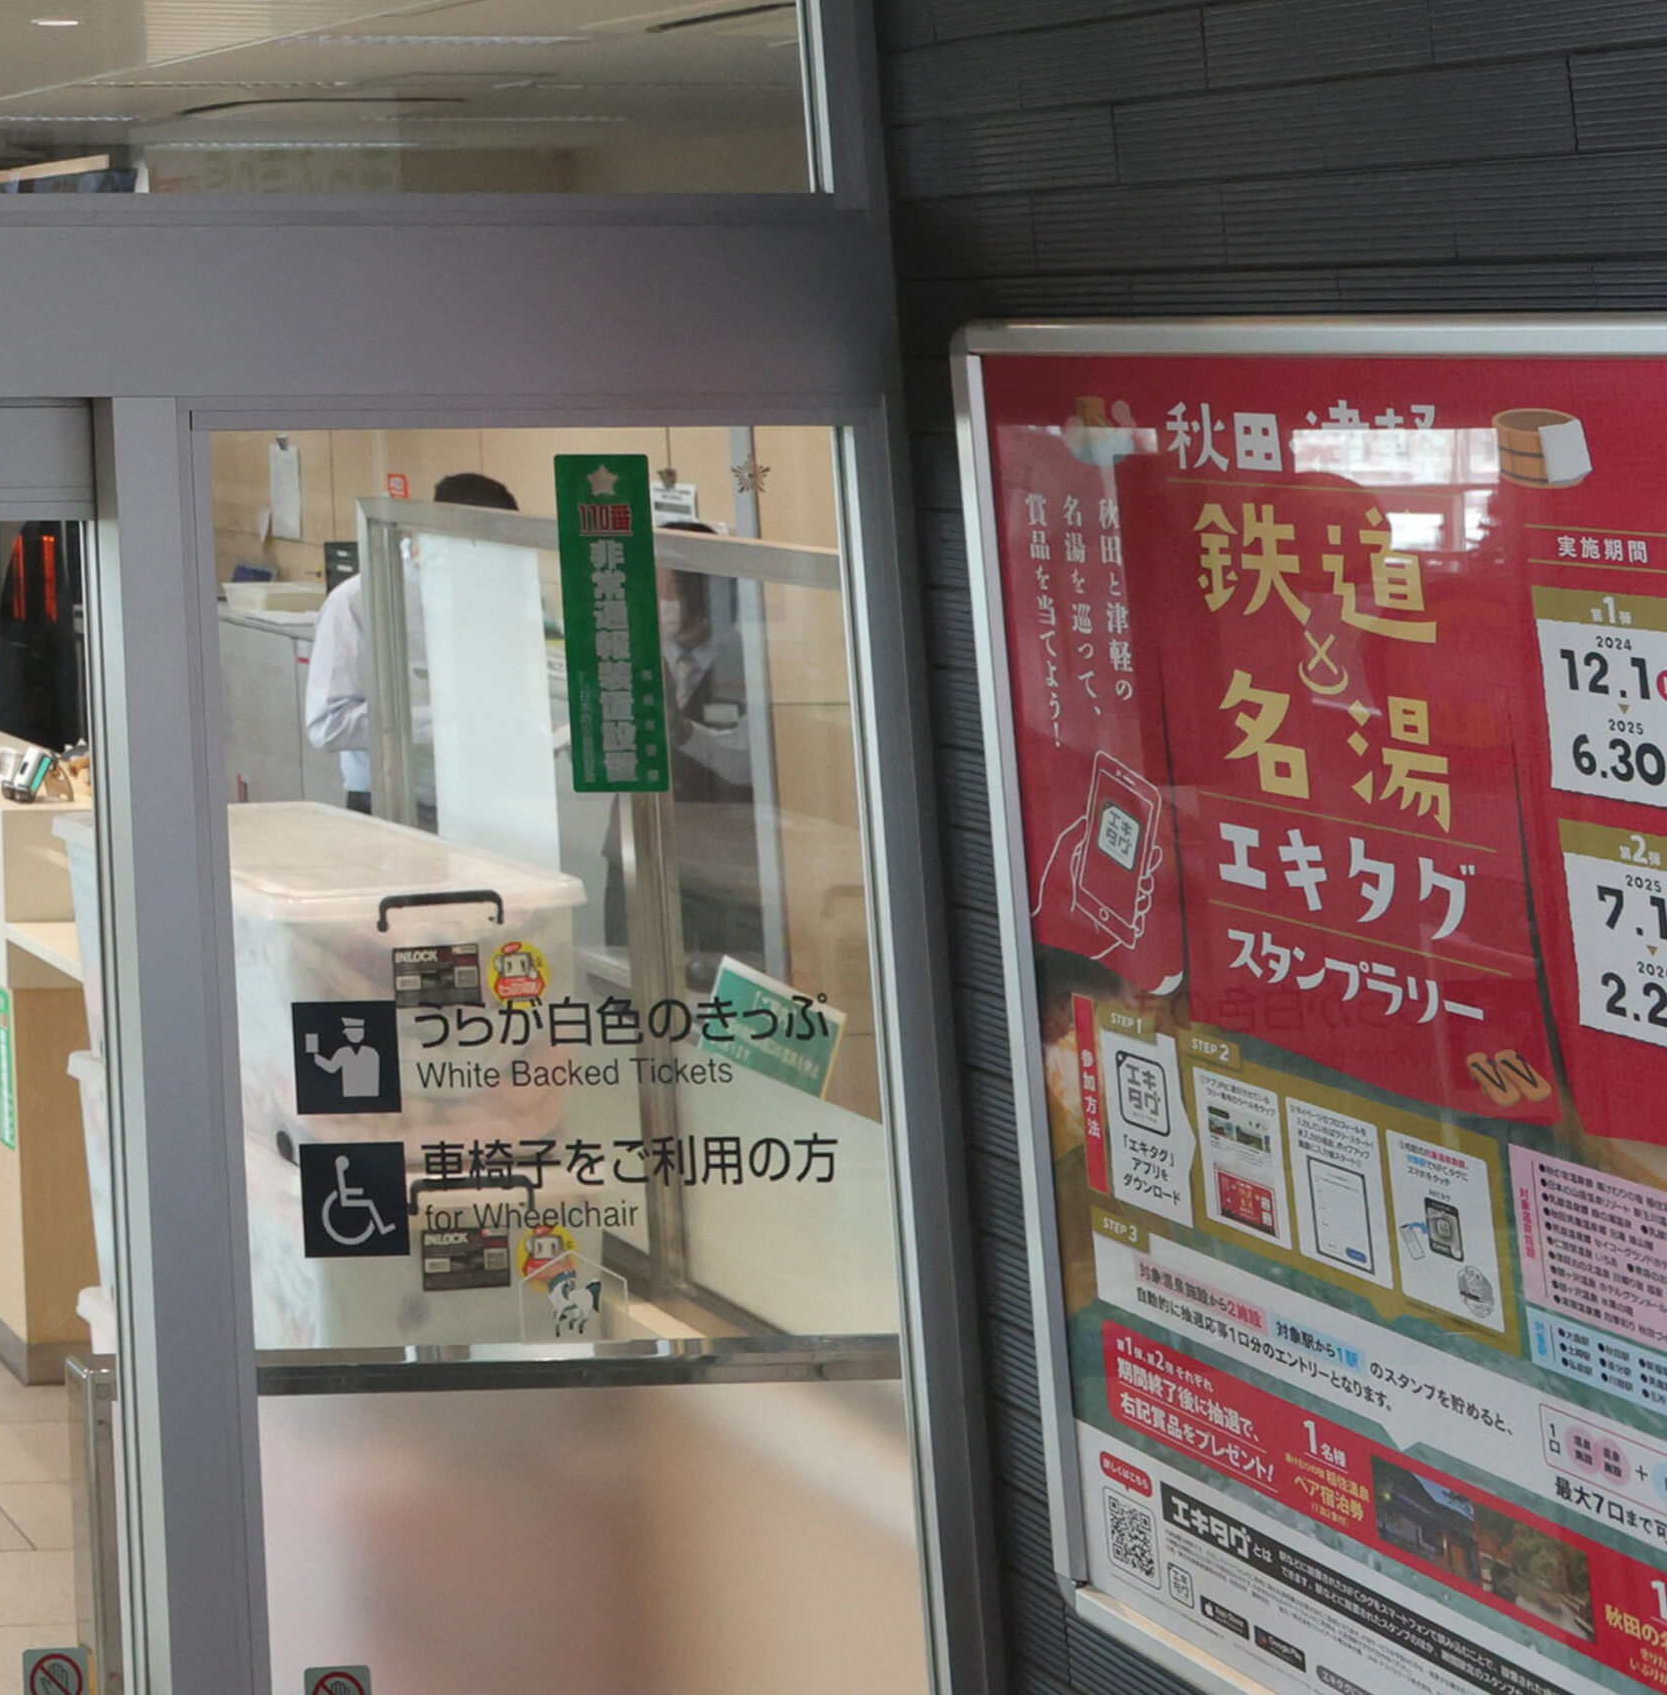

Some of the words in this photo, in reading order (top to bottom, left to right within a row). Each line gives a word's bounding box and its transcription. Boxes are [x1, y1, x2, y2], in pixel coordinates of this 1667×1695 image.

[579, 504, 632, 535] 110番
[1556, 535, 1649, 564] 実施期間
[1062, 494, 1102, 716] 名湯を巡って、
[1097, 497, 1134, 702] 秋田と津軽の
[1595, 636, 1633, 652] 2024
[1559, 648, 1651, 701] 12.1
[1607, 718, 1645, 736] 2025
[1218, 669, 1454, 834] 名湯
[1572, 734, 1667, 786] 6.30
[1218, 822, 1477, 941] エキタグ
[1624, 874, 1662, 893] 2025
[1228, 927, 1486, 1024] スタンプラリー
[1110, 1012, 1135, 1028] STEP
[1191, 1037, 1218, 1055] STEP
[1219, 1044, 1230, 1061] 2
[417, 1060, 501, 1089] White
[512, 1058, 620, 1088] Backed
[629, 1056, 734, 1086] Tickets
[1080, 1048, 1101, 1140] 参加方法
[421, 1133, 839, 1190] 車椅子をご利用の方
[1131, 1156, 1169, 1183] アプリを
[1123, 1172, 1181, 1206] ダウンロード
[424, 1203, 466, 1231] for
[474, 1200, 640, 1230] Wheelchair
[1102, 1217, 1127, 1235] STEP
[1128, 1225, 1138, 1242] 3
[1117, 1357, 1261, 1443] 期間終了後に抽選で、
